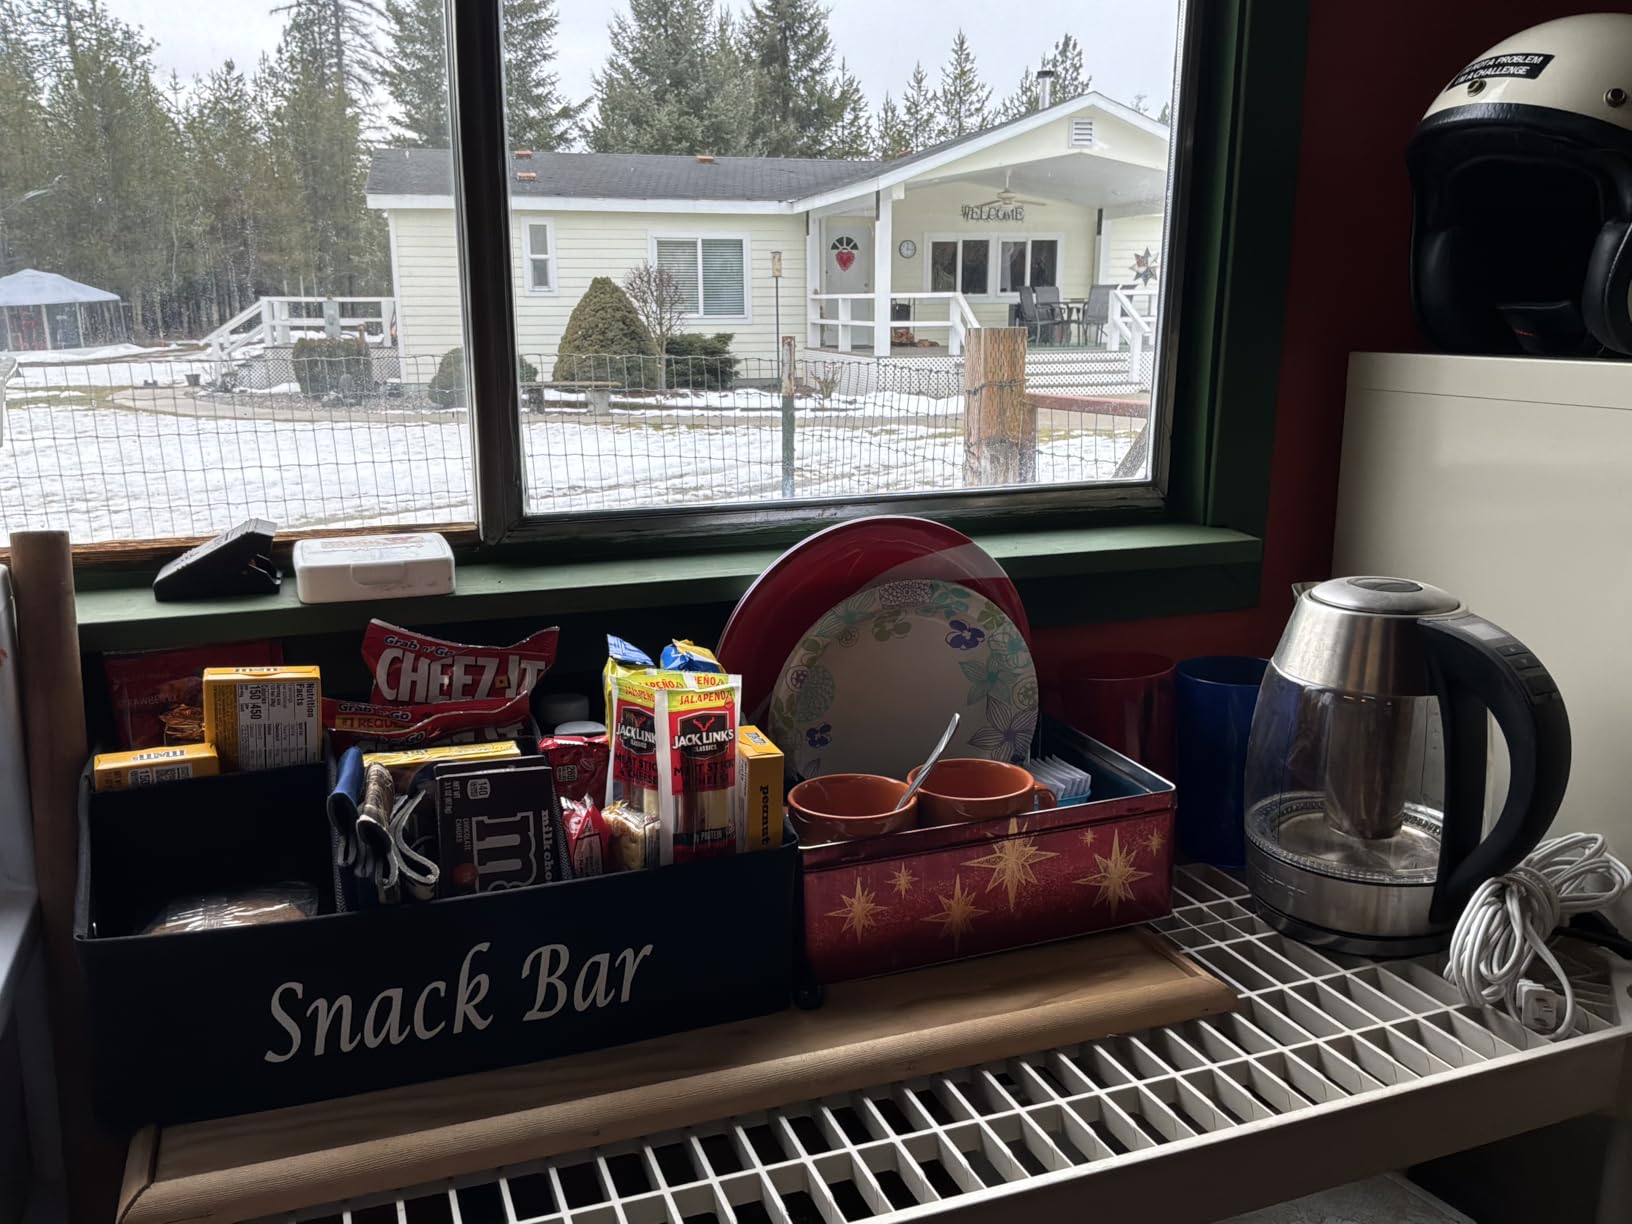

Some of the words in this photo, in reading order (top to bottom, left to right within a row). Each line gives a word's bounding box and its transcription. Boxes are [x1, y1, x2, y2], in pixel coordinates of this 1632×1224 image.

[1495, 55, 1543, 64] PROBLEM
[1472, 66, 1530, 78] CHALLENGE
[961, 203, 1025, 222] WELCOME
[384, 635, 420, 650] Grab
[249, 686, 261, 700] 150
[296, 683, 305, 706] Facts
[306, 683, 315, 718] Nutrition
[250, 704, 262, 720] 450
[338, 703, 375, 713] Grab
[389, 711, 411, 721] Go
[615, 723, 636, 739] JACK
[672, 733, 702, 750] JACK
[639, 758, 657, 771] STIC
[566, 766, 576, 781] 260
[478, 782, 488, 796] 140
[760, 784, 771, 845] peanut
[541, 809, 553, 850] milk
[543, 851, 554, 882] cho
[264, 942, 495, 1063] Snack
[521, 943, 654, 1022] Bar
